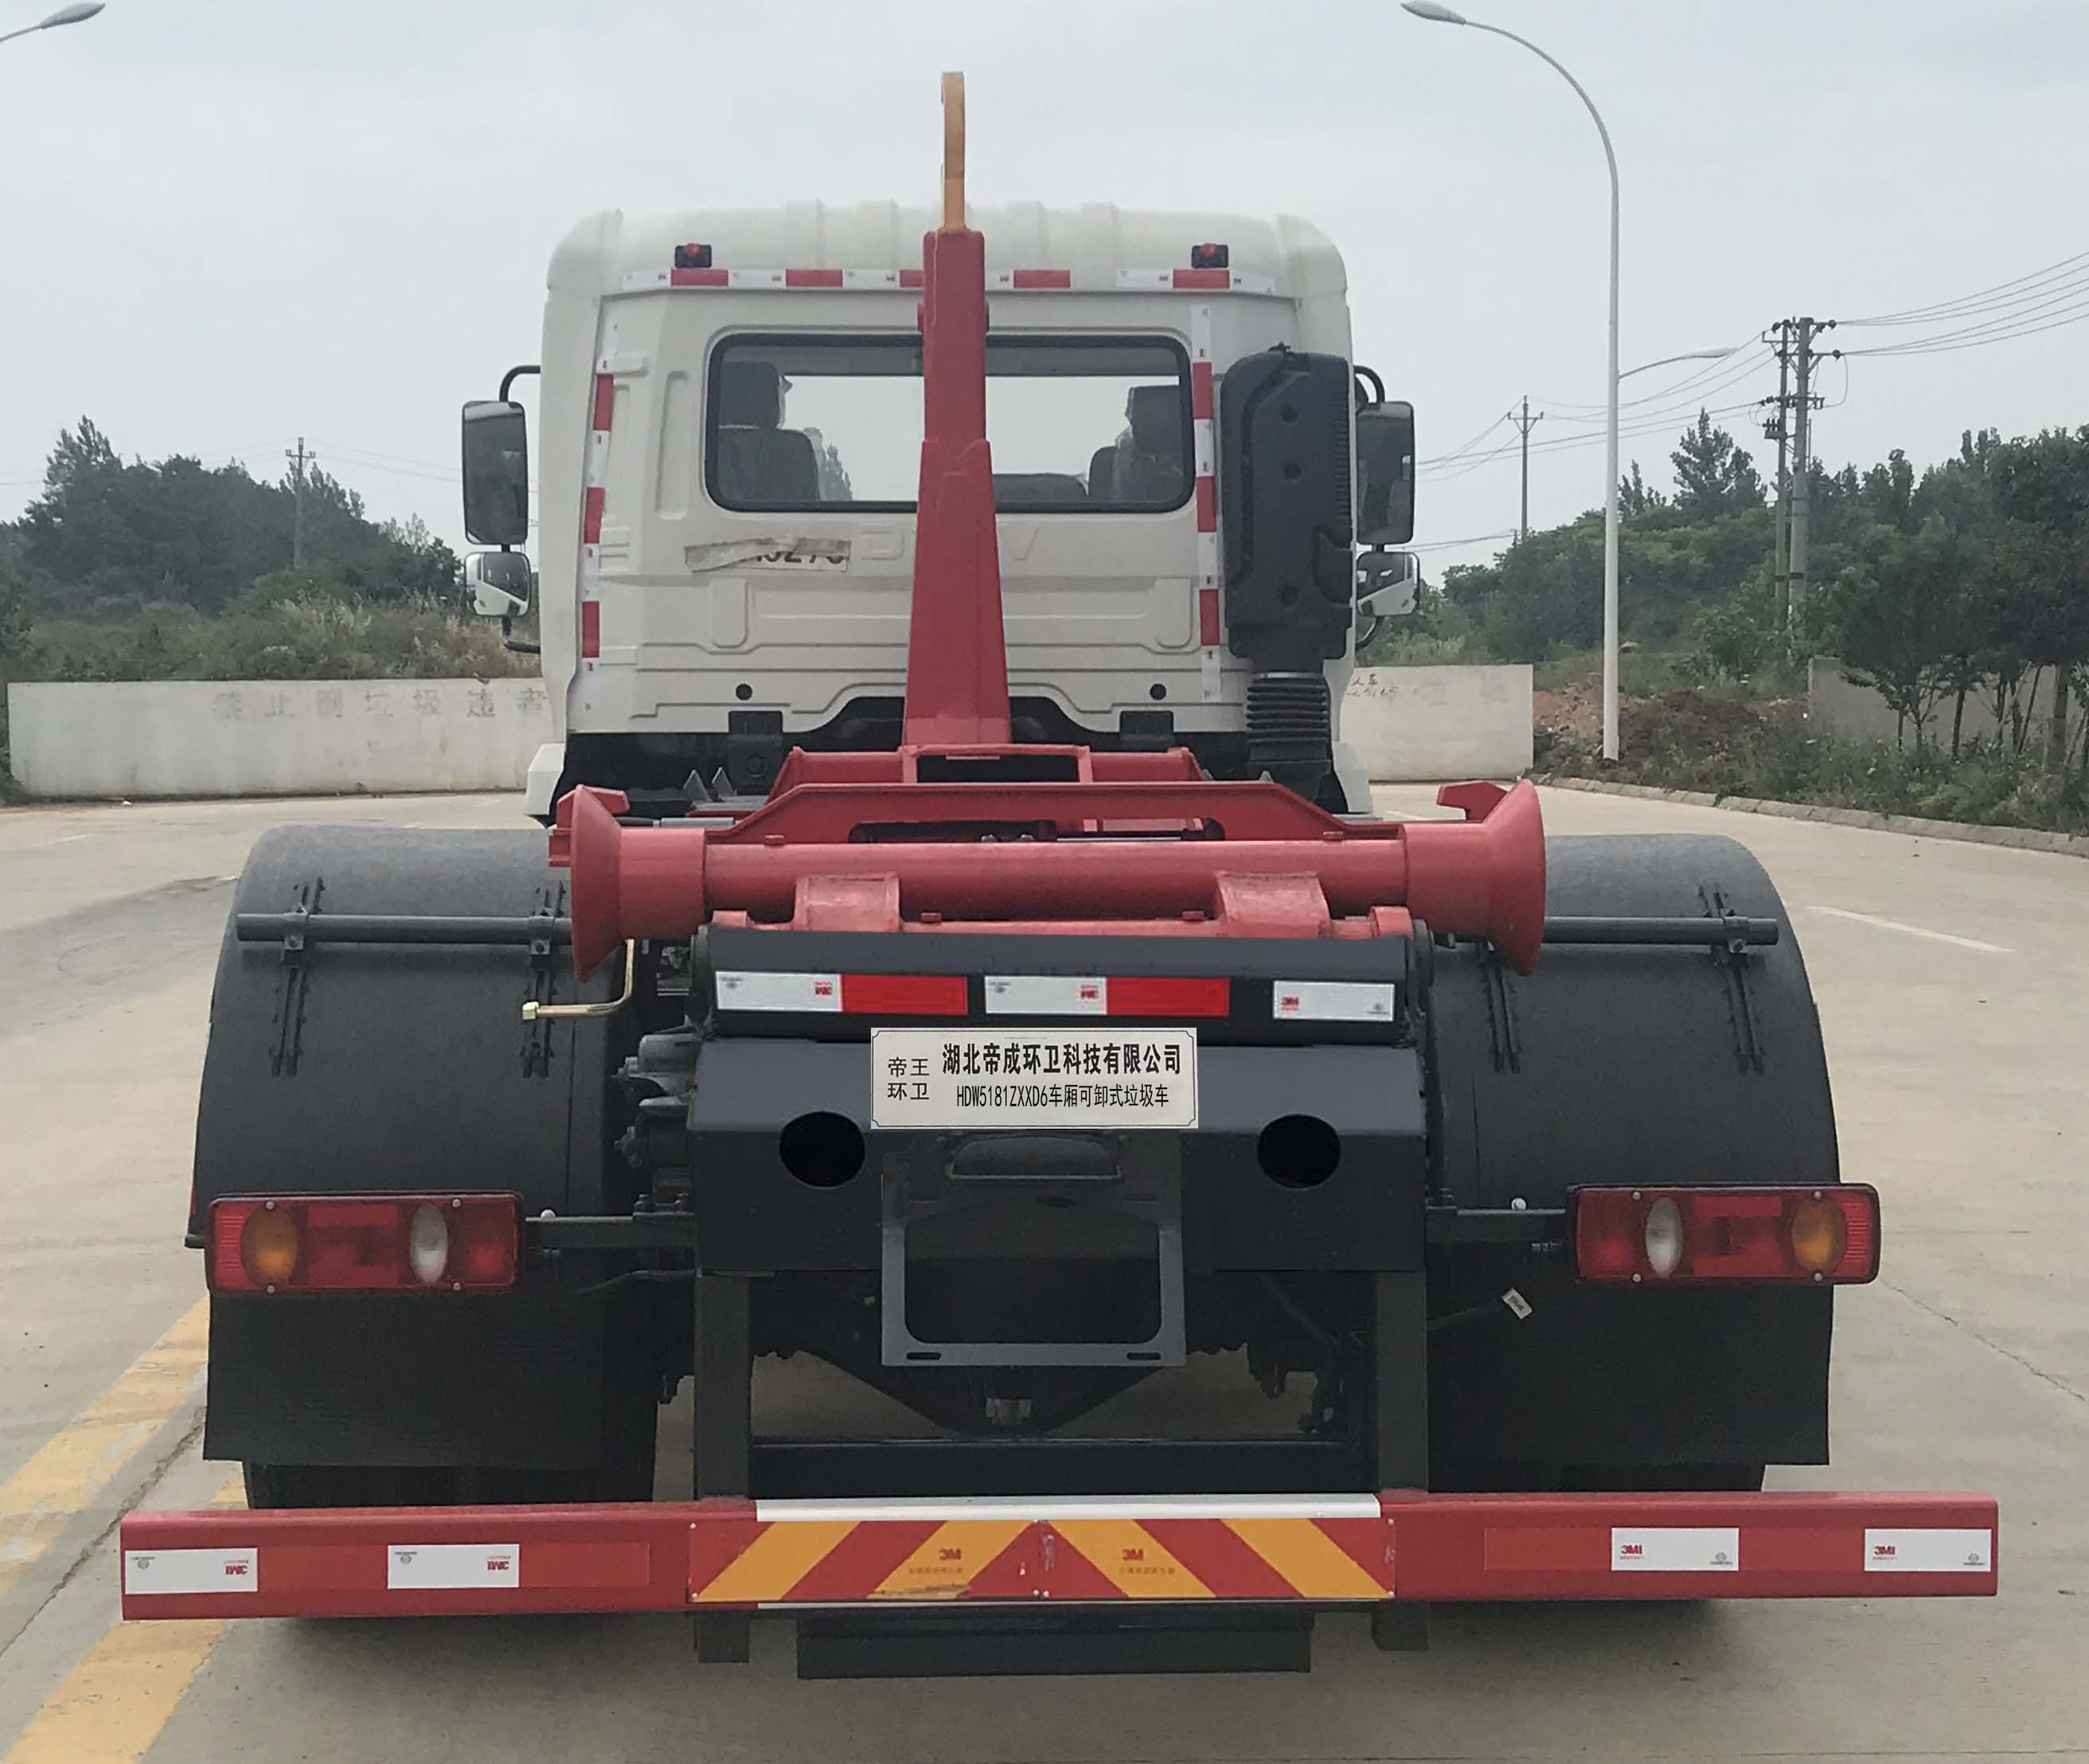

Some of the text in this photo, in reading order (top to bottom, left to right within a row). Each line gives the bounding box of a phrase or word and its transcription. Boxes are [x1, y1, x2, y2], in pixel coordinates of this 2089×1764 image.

[943, 1043, 1181, 1075] 湖北帝成环卫科技有限公司
[888, 1057, 930, 1077] 帝王
[888, 1083, 930, 1100] 环卫
[957, 1083, 1169, 1107] HDW5181ZXXD6车厢可卸式垃圾车
[940, 1549, 961, 1560] 3M
[1123, 1549, 1143, 1560] 3M
[1621, 1544, 1643, 1554] 3M
[1874, 1546, 1896, 1555] 3M
